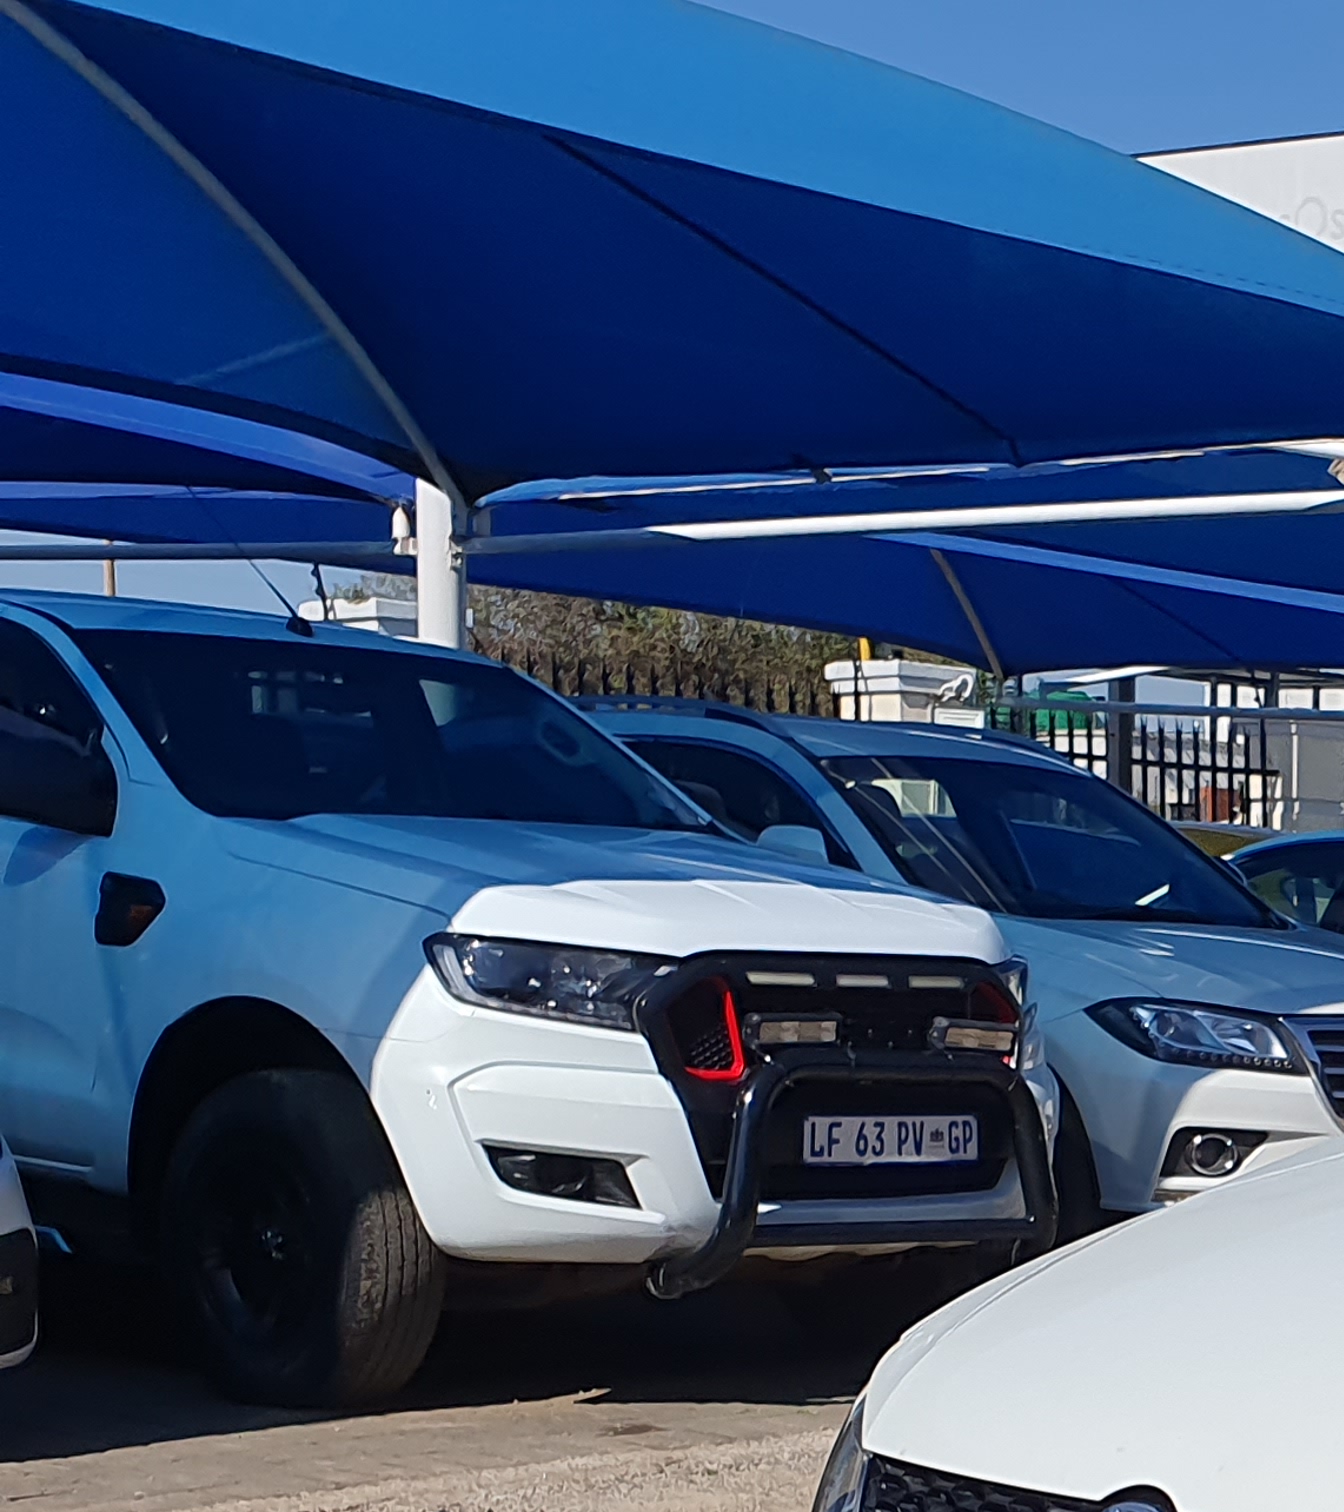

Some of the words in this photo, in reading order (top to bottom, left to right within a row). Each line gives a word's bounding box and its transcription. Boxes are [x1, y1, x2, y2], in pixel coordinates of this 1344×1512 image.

[810, 1121, 843, 1158] LF
[855, 1121, 886, 1157] 63
[896, 1120, 925, 1157] PV
[948, 1120, 974, 1155] GP
